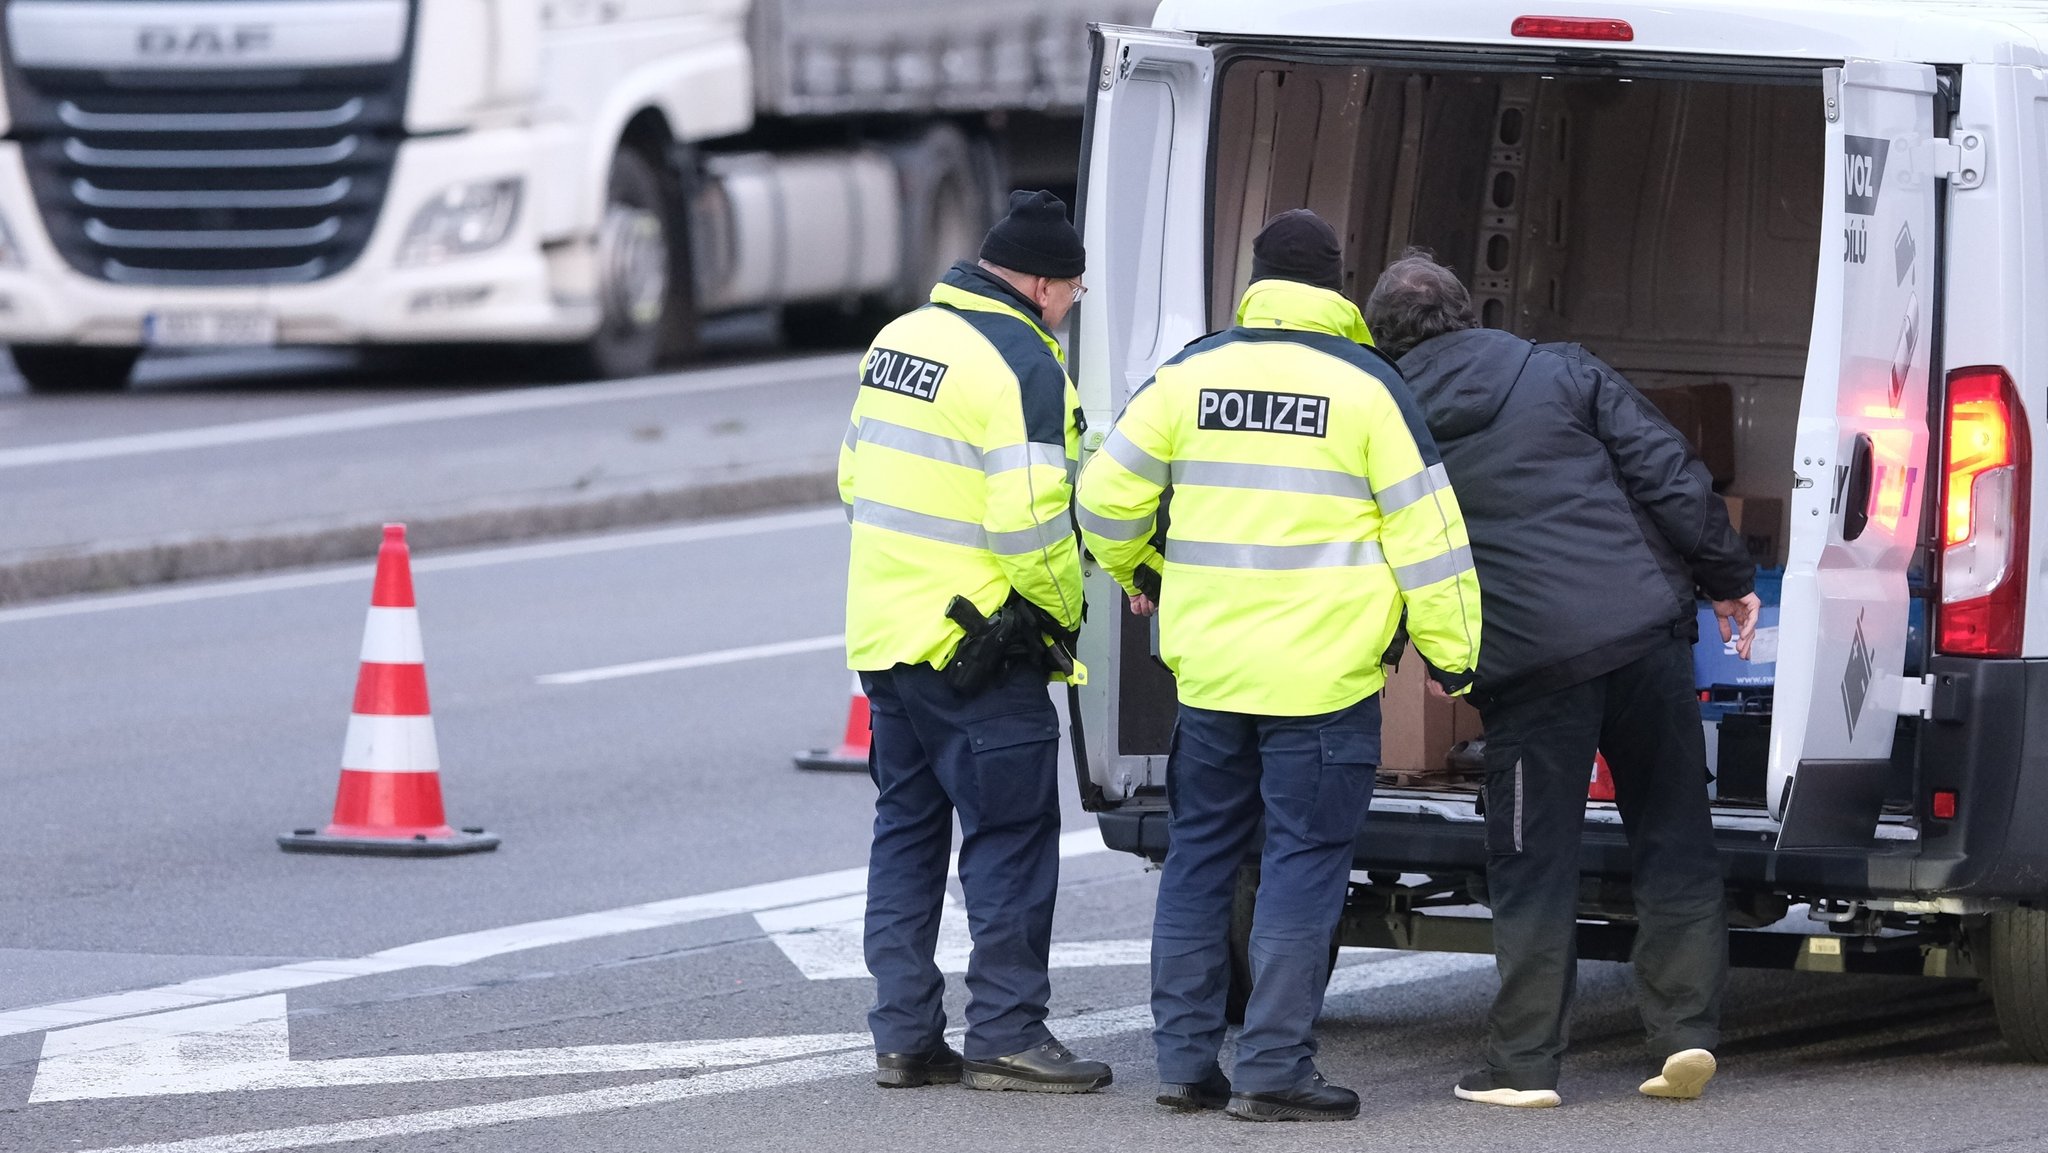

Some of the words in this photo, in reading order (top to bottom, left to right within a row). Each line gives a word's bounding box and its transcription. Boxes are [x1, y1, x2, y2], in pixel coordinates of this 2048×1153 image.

[137, 23, 273, 52] DAF
[867, 350, 945, 400] POLIZEI
[1199, 391, 1327, 435] POLIZEI
